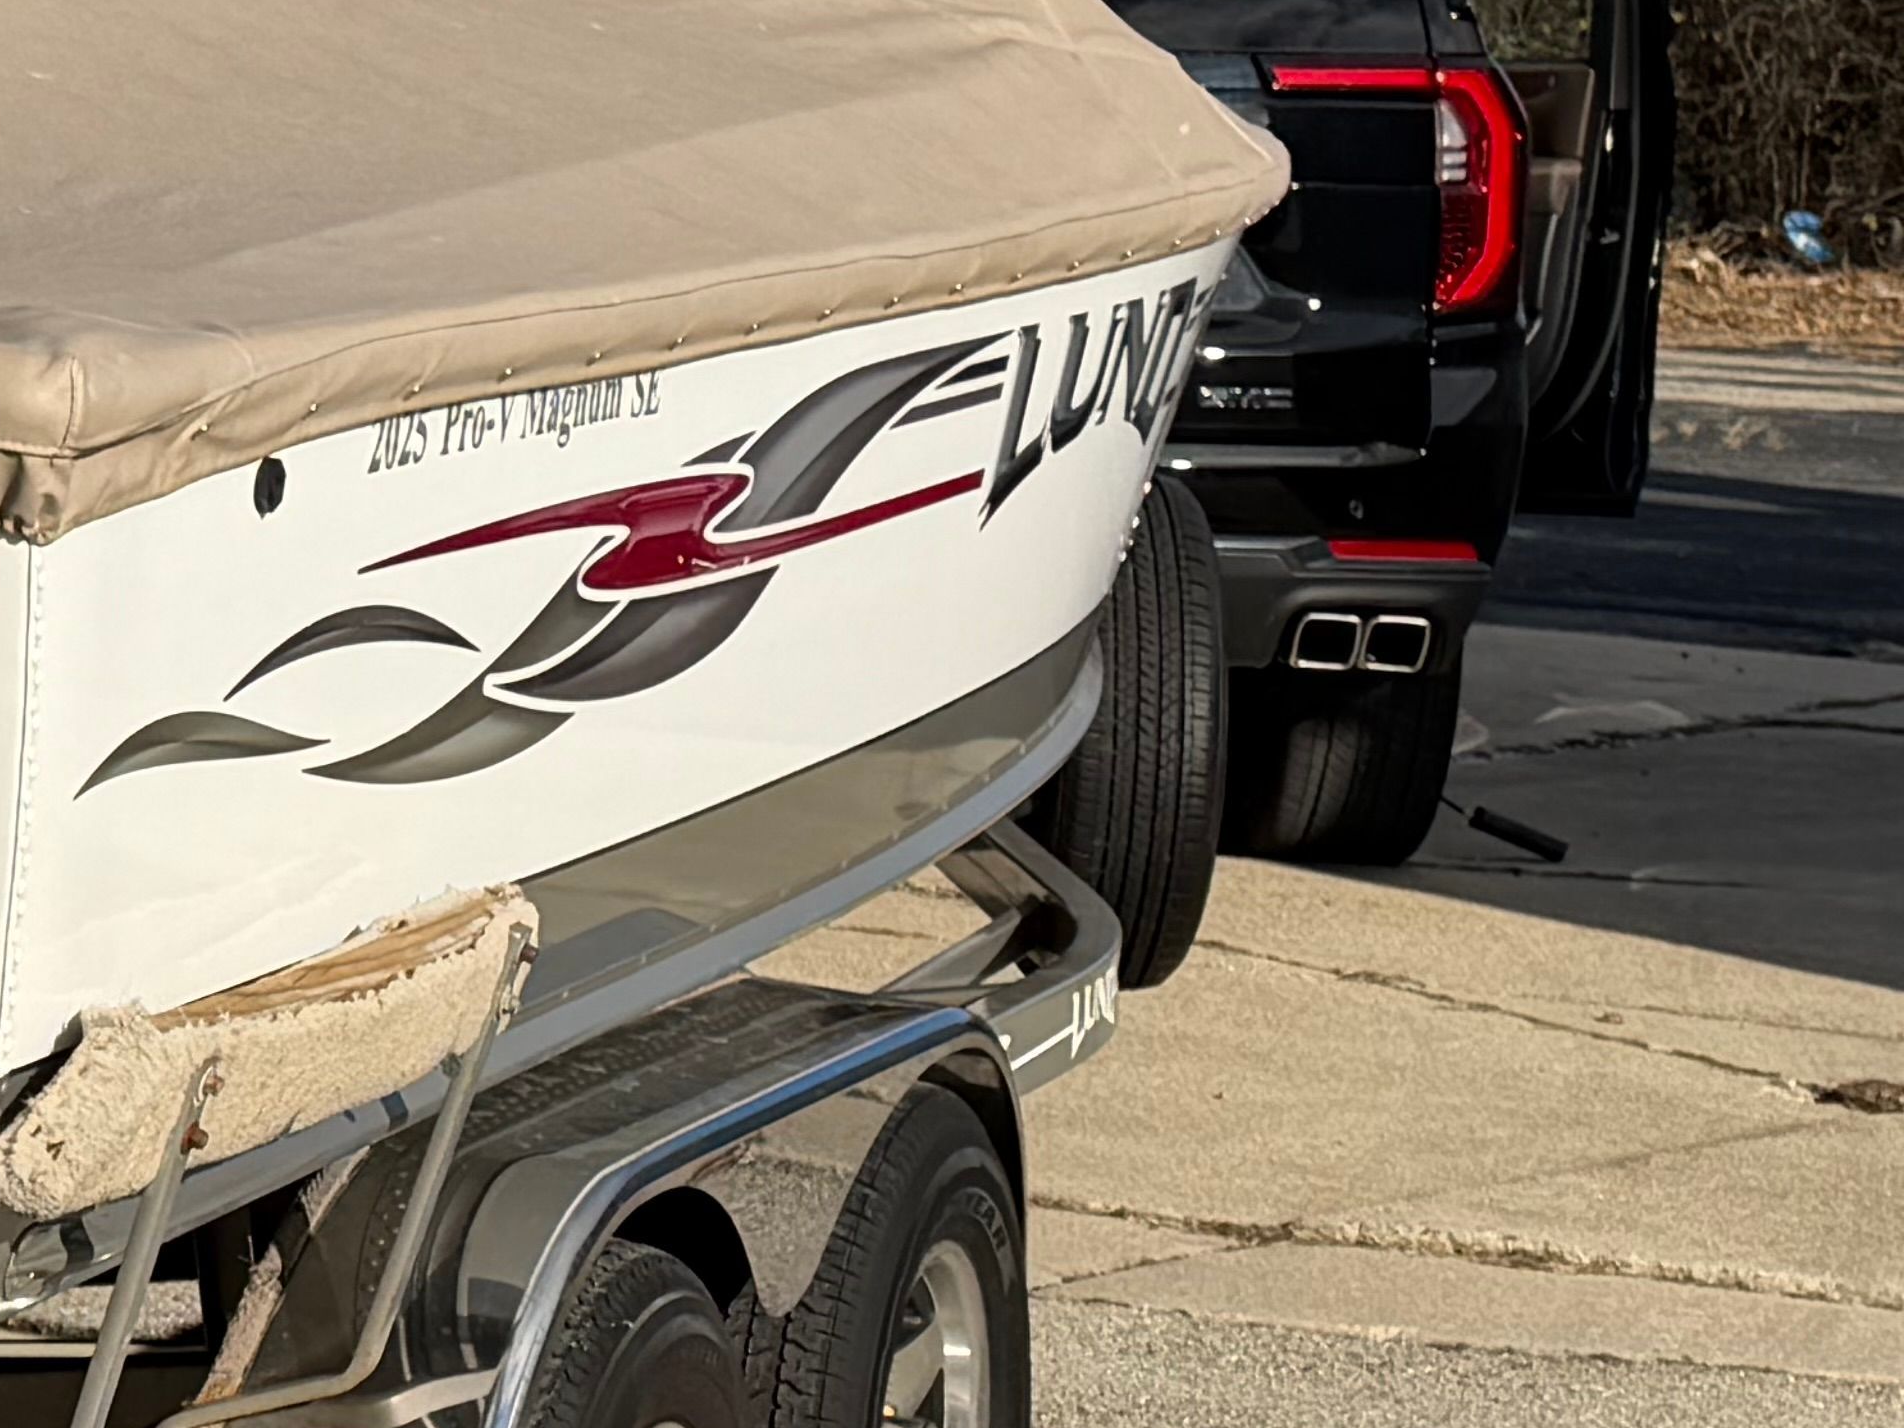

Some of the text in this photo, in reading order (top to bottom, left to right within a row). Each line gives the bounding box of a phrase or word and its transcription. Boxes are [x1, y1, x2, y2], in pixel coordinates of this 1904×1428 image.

[366, 371, 660, 474] 2025 Pro-V Magnum SE
